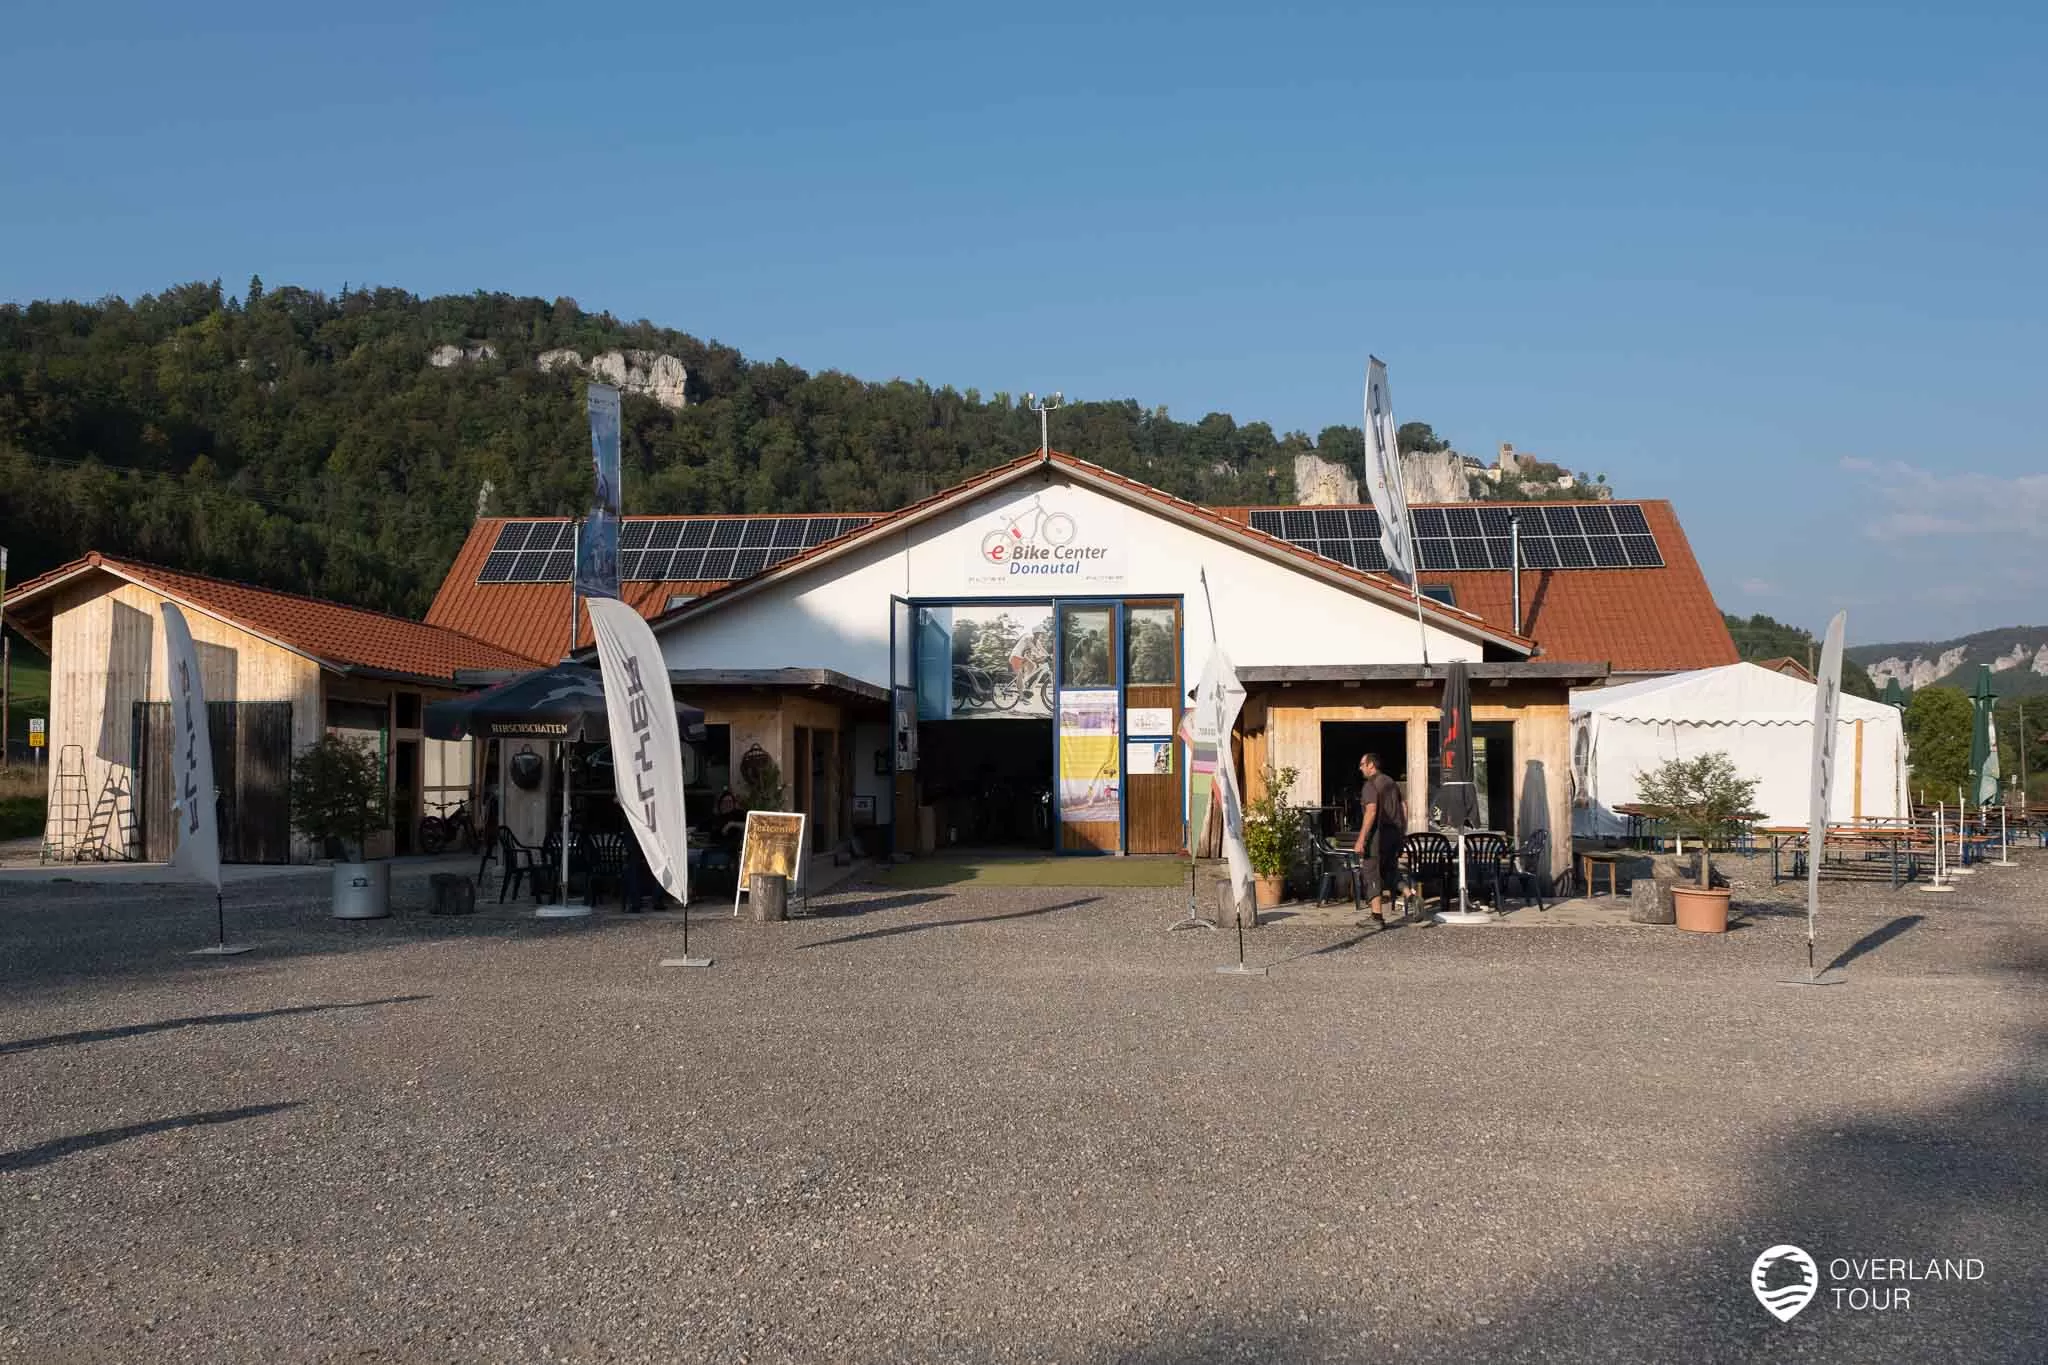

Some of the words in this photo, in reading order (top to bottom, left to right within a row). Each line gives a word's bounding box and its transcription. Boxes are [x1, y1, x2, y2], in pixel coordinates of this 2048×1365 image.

[989, 545, 1005, 560] e
[1012, 545, 1050, 560] Bike
[1054, 545, 1108, 560] Center
[1009, 561, 1081, 575] Donautal
